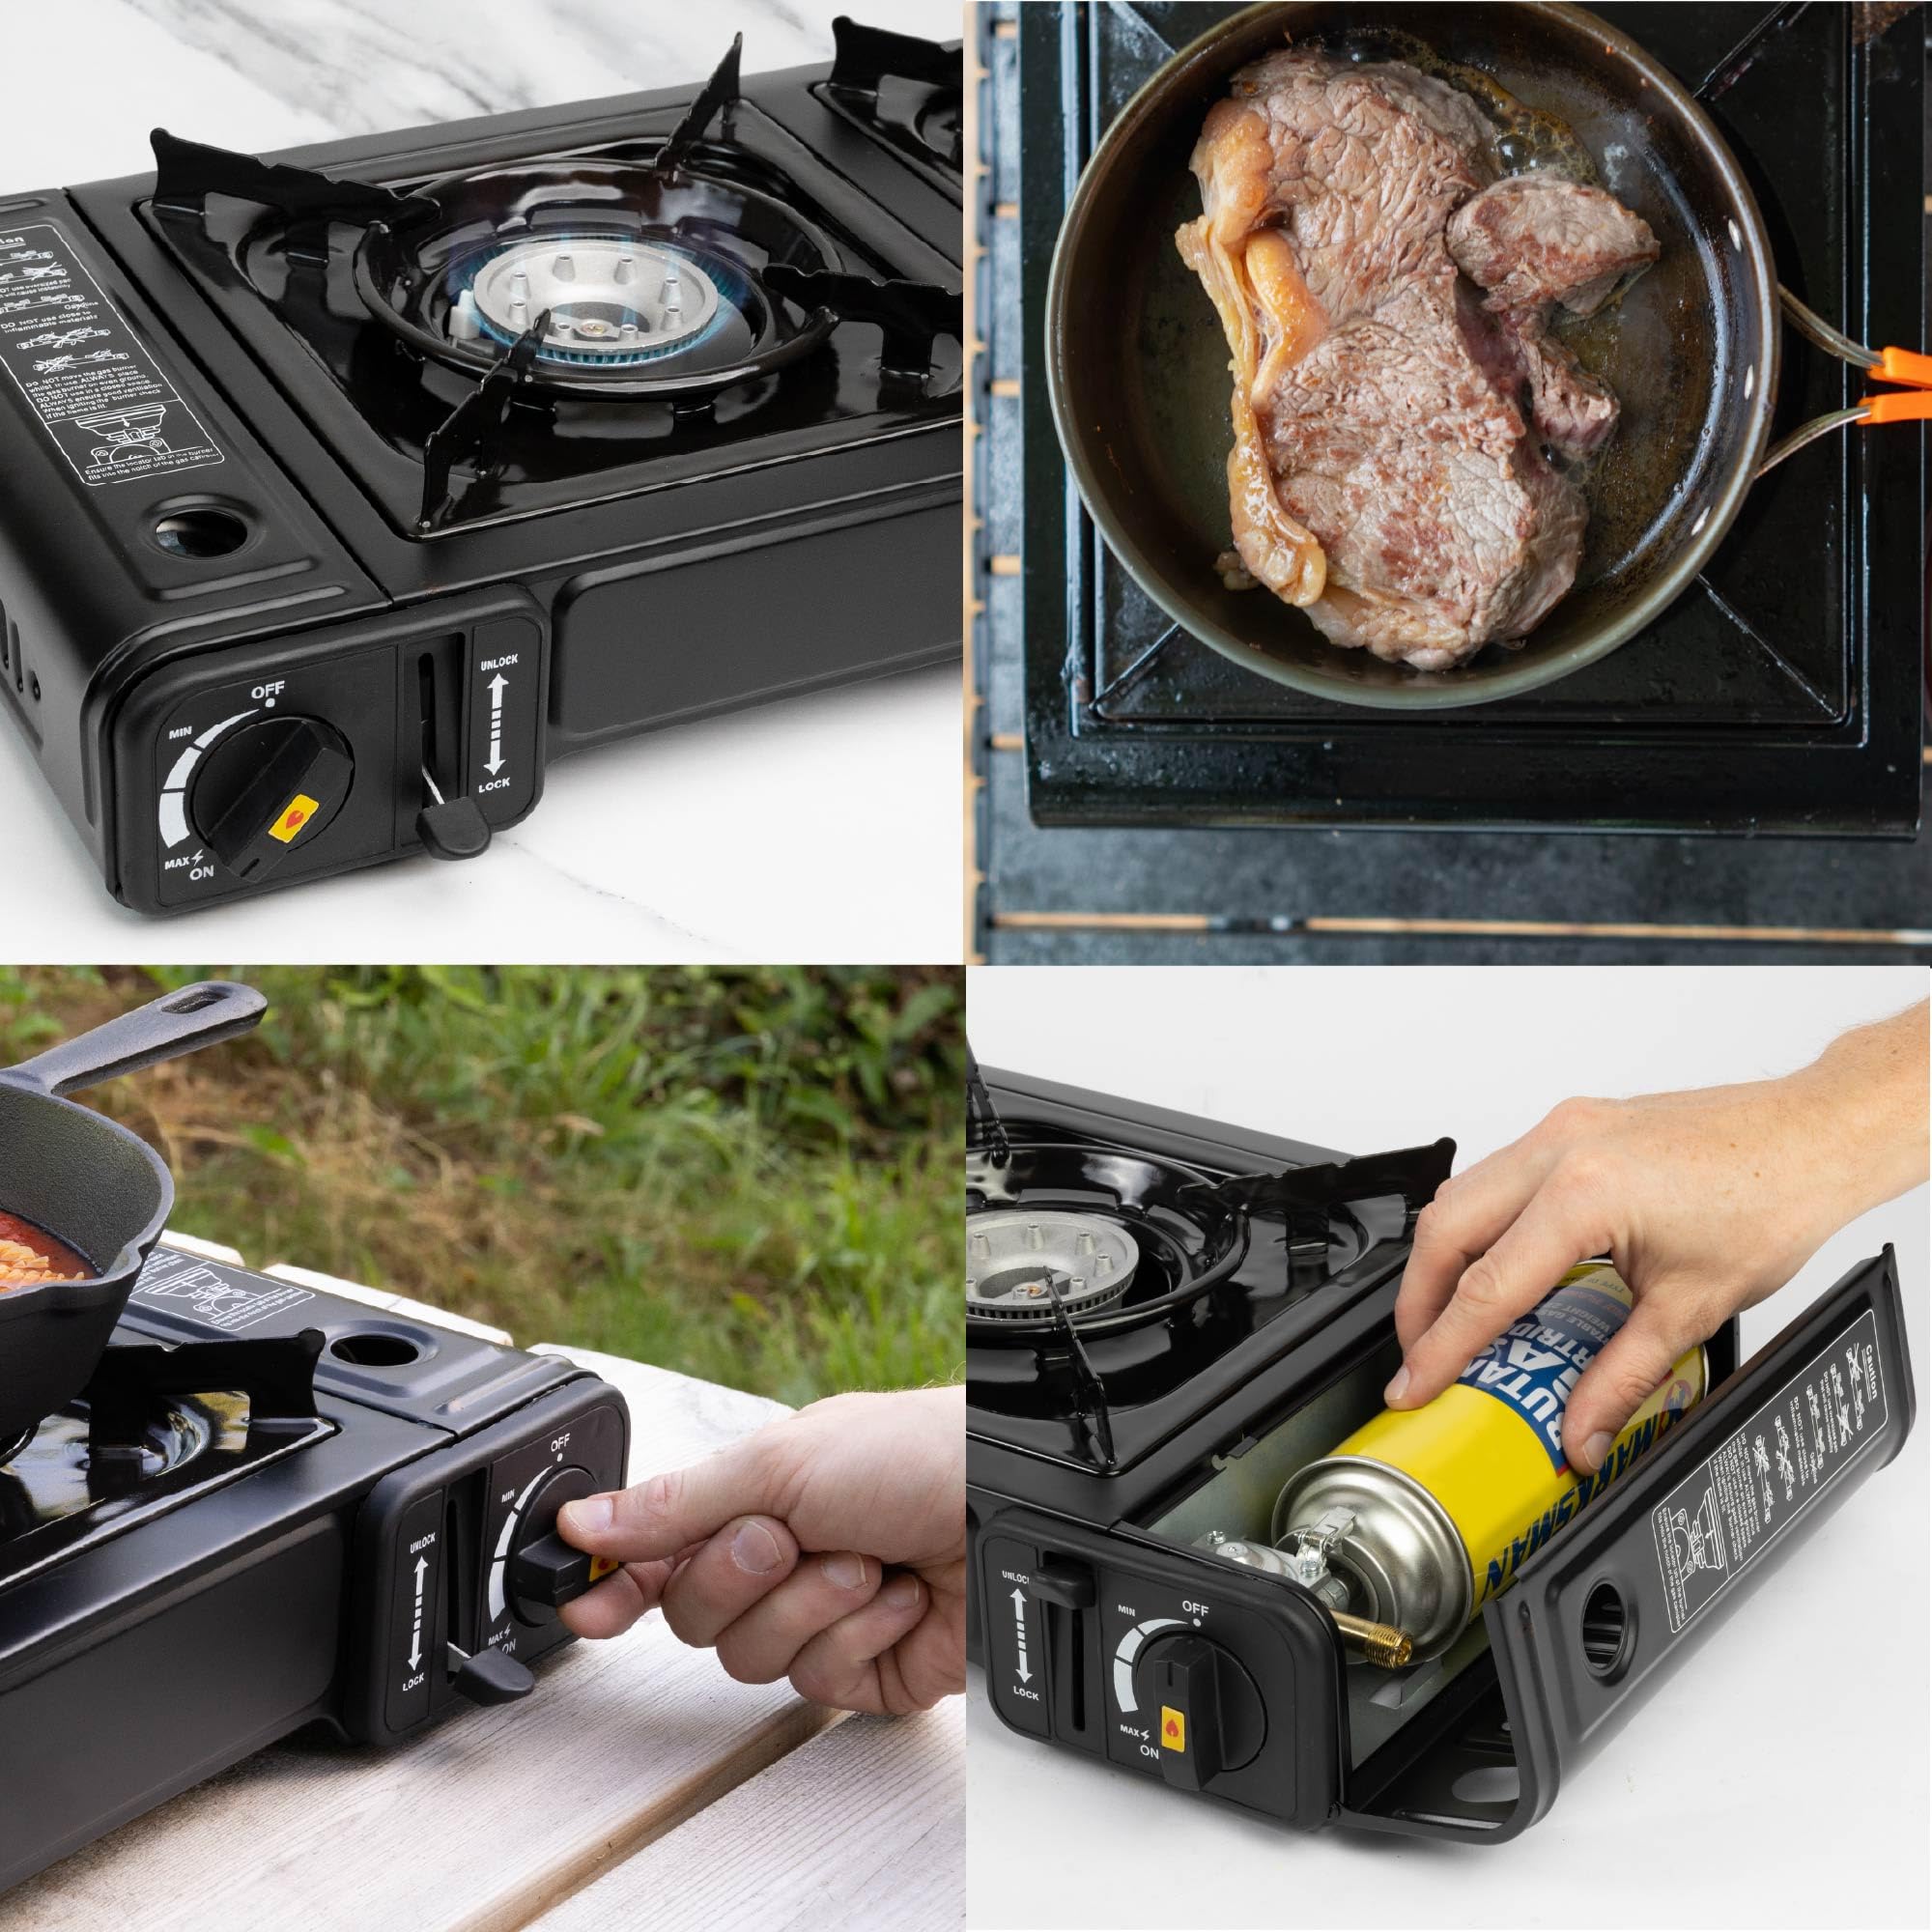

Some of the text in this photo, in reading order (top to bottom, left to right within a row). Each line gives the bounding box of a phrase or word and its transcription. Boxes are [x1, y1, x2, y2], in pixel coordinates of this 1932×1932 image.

[59, 315, 98, 324] materials
[480, 653, 518, 670] UNLOCK
[251, 680, 285, 700] OFF
[168, 725, 192, 740] MIN
[478, 777, 510, 793] LOCK
[164, 856, 189, 871] MAX
[189, 866, 214, 881] ON
[1561, 1305, 1611, 1333] WEIGHT
[1506, 1322, 1595, 1372] RTRID
[1866, 1345, 1878, 1400] Caution
[551, 1433, 570, 1453] OFF
[501, 1489, 515, 1503] MIN
[410, 1532, 436, 1554] UNLOCK
[1118, 1605, 1136, 1617] MIN
[1182, 1600, 1209, 1617] OFF
[488, 1630, 503, 1645] MAX
[501, 1638, 516, 1653] ON
[403, 1672, 424, 1691] LOCK
[1013, 1686, 1039, 1701] LOCK
[1120, 1723, 1140, 1737] MAX
[1140, 1745, 1159, 1760] ON
